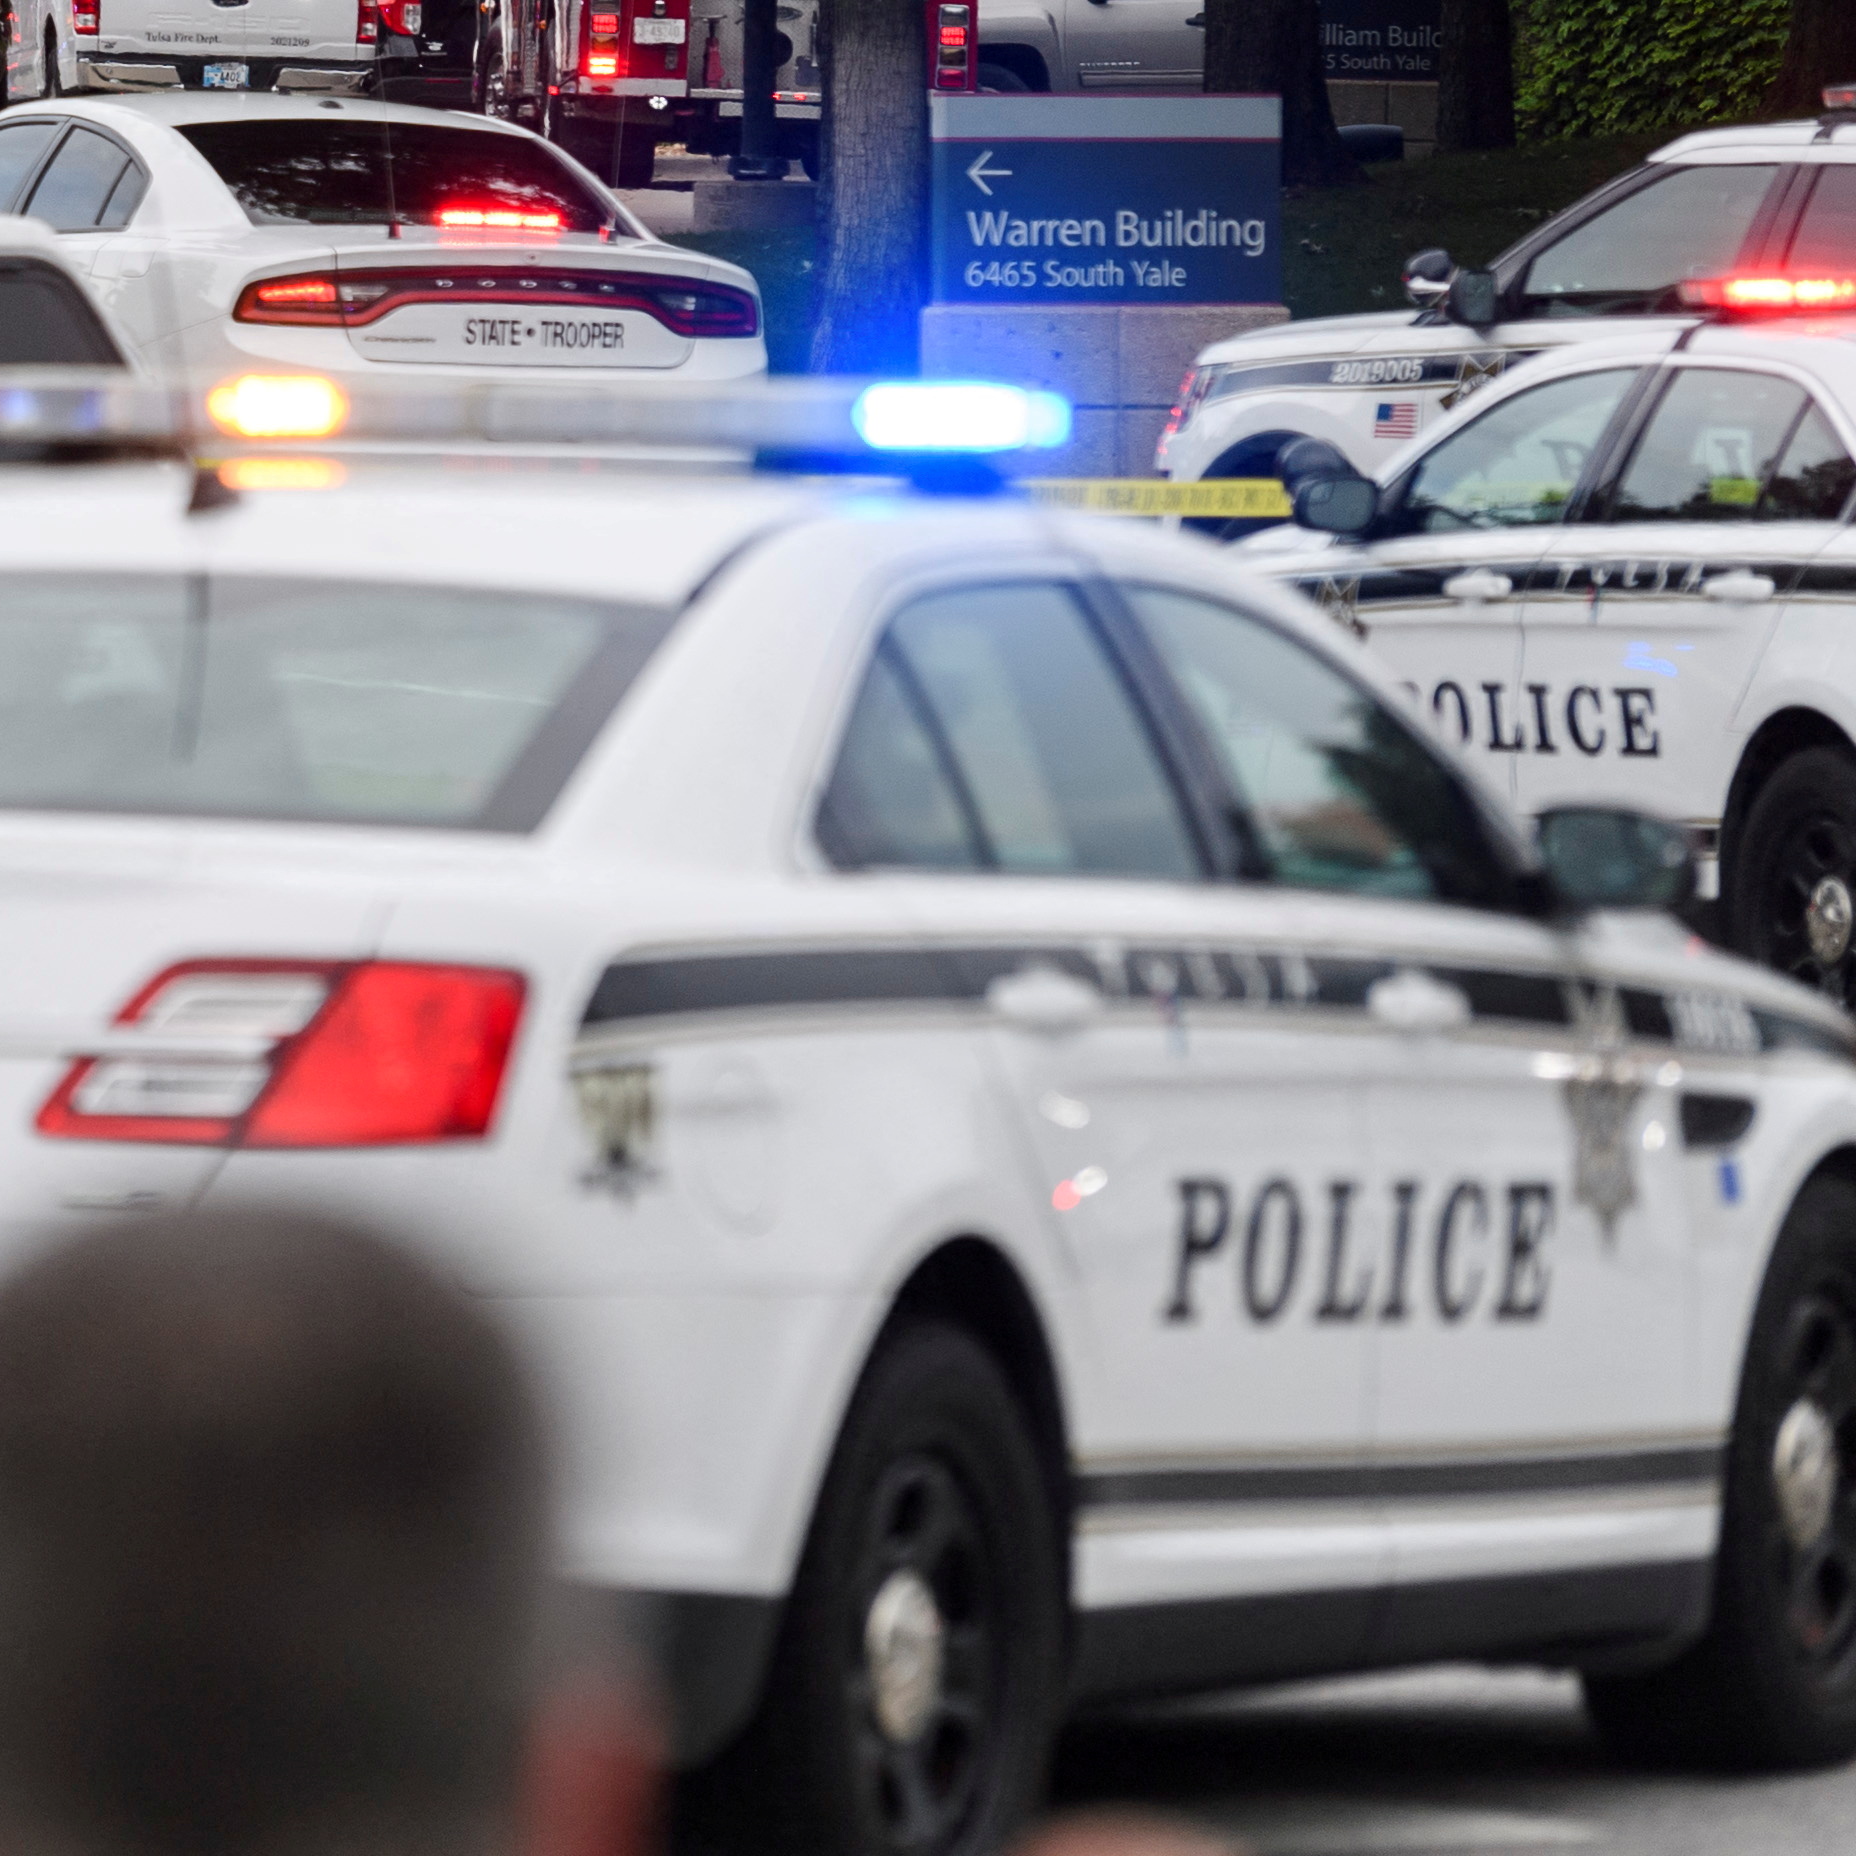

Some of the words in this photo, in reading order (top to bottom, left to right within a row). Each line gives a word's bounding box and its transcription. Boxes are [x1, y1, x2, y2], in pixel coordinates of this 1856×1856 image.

[144, 31, 172, 43] Tulsa
[174, 32, 194, 43] Fire
[1340, 53, 1391, 70] South
[1394, 53, 1432, 71] Yale
[966, 209, 1107, 247] Warren
[1114, 208, 1267, 257] Building
[964, 259, 1037, 287] 6465
[1043, 258, 1125, 287] South
[1131, 259, 1187, 287] Yale
[465, 318, 523, 346] STATE
[540, 320, 626, 349] TROOPER
[1330, 358, 1425, 384] 2019005
[1399, 679, 1661, 759] OLICE
[1158, 1175, 1557, 1326] POLICE
